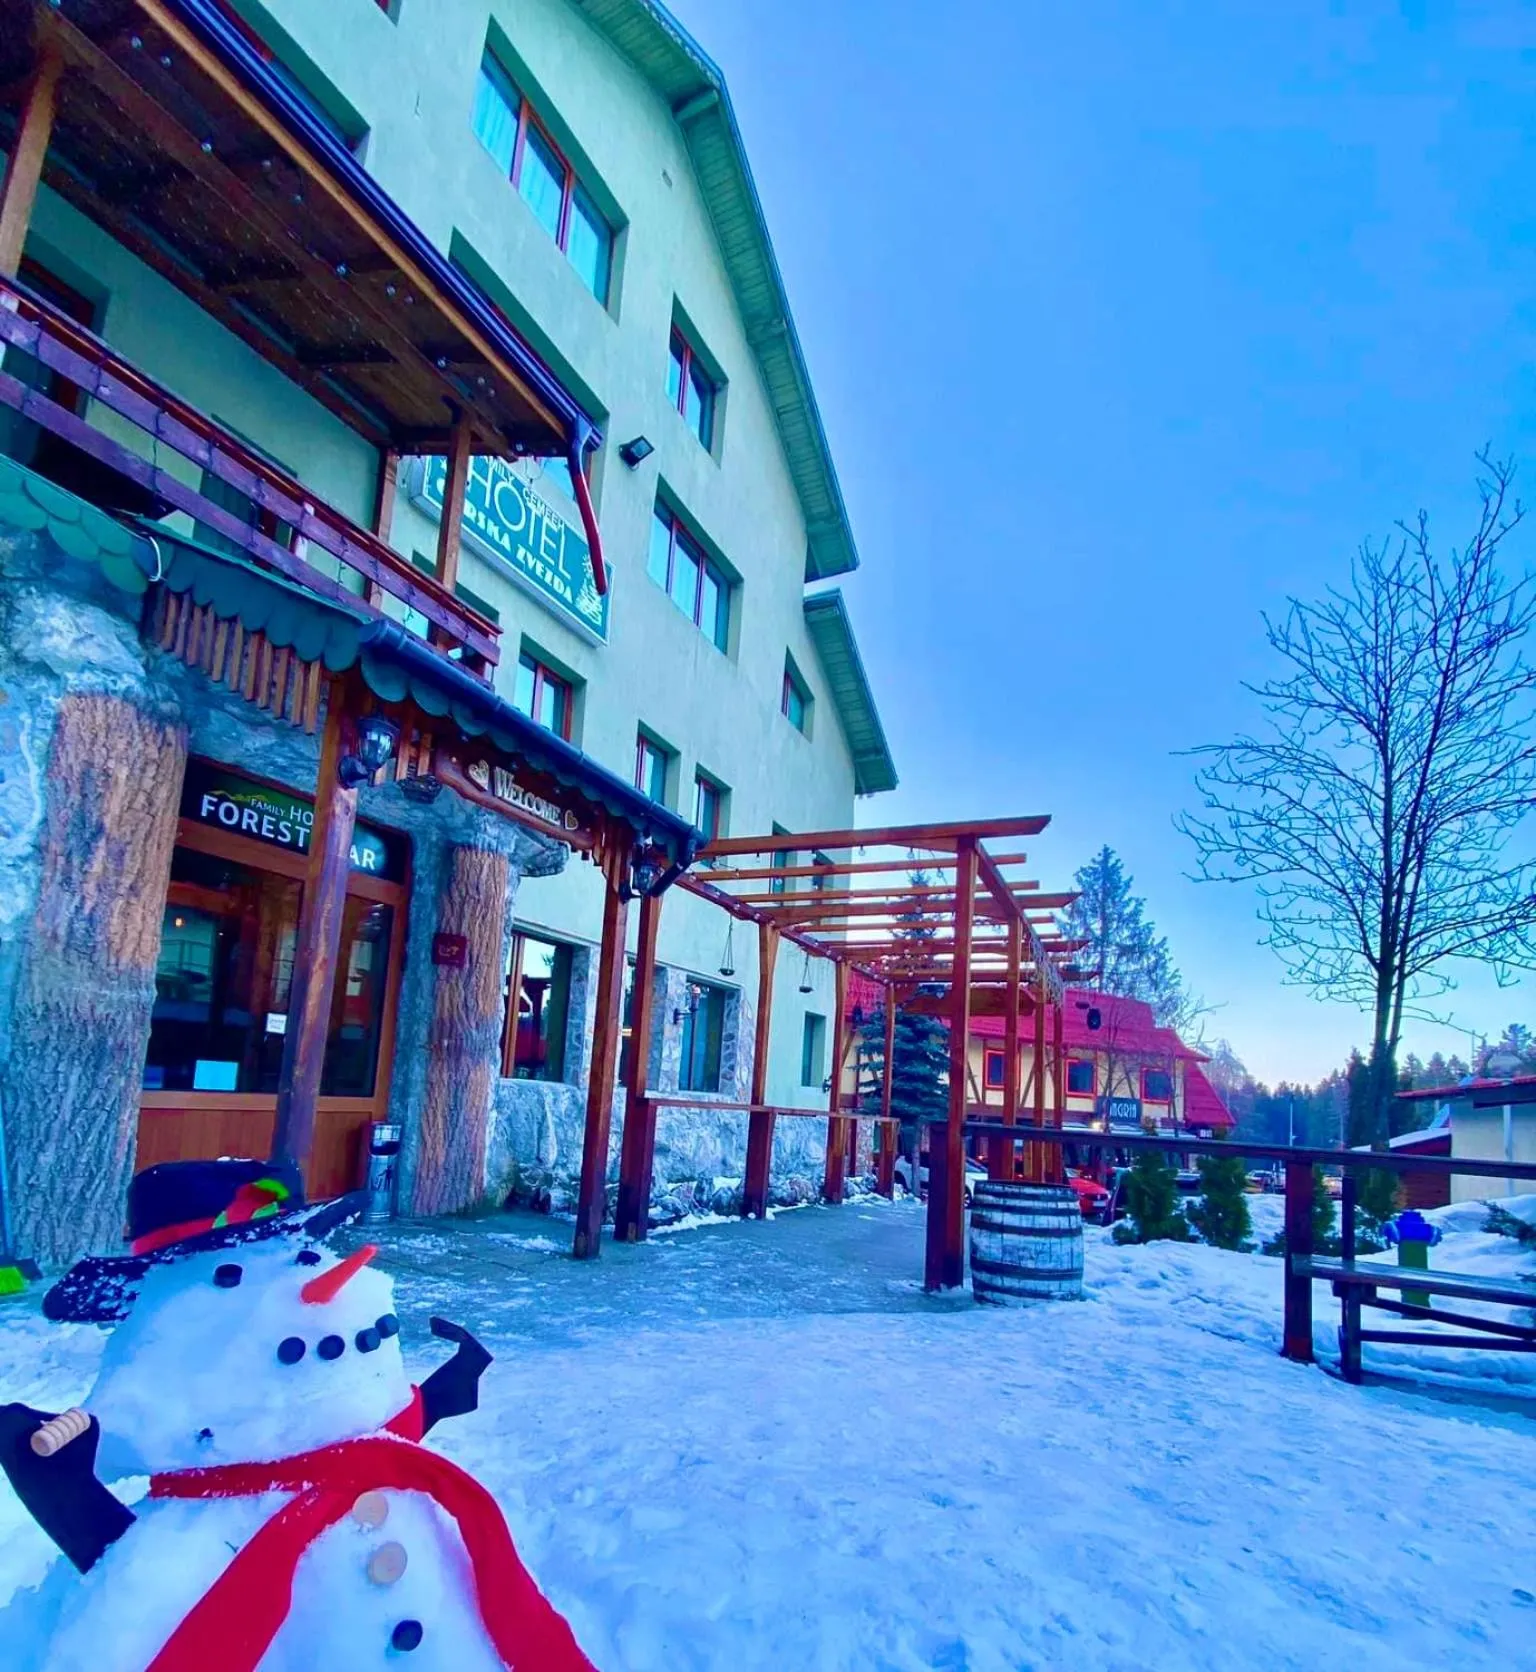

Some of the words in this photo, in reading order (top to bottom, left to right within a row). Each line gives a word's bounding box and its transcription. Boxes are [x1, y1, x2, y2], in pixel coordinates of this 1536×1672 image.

[467, 456, 571, 580] HOTEL
[516, 544, 573, 603] ZVEZDA
[201, 794, 311, 848] FOREST
[251, 798, 286, 817] FAMILY
[290, 805, 314, 826] HO
[494, 766, 561, 826] WELCOME
[350, 844, 375, 870] AR
